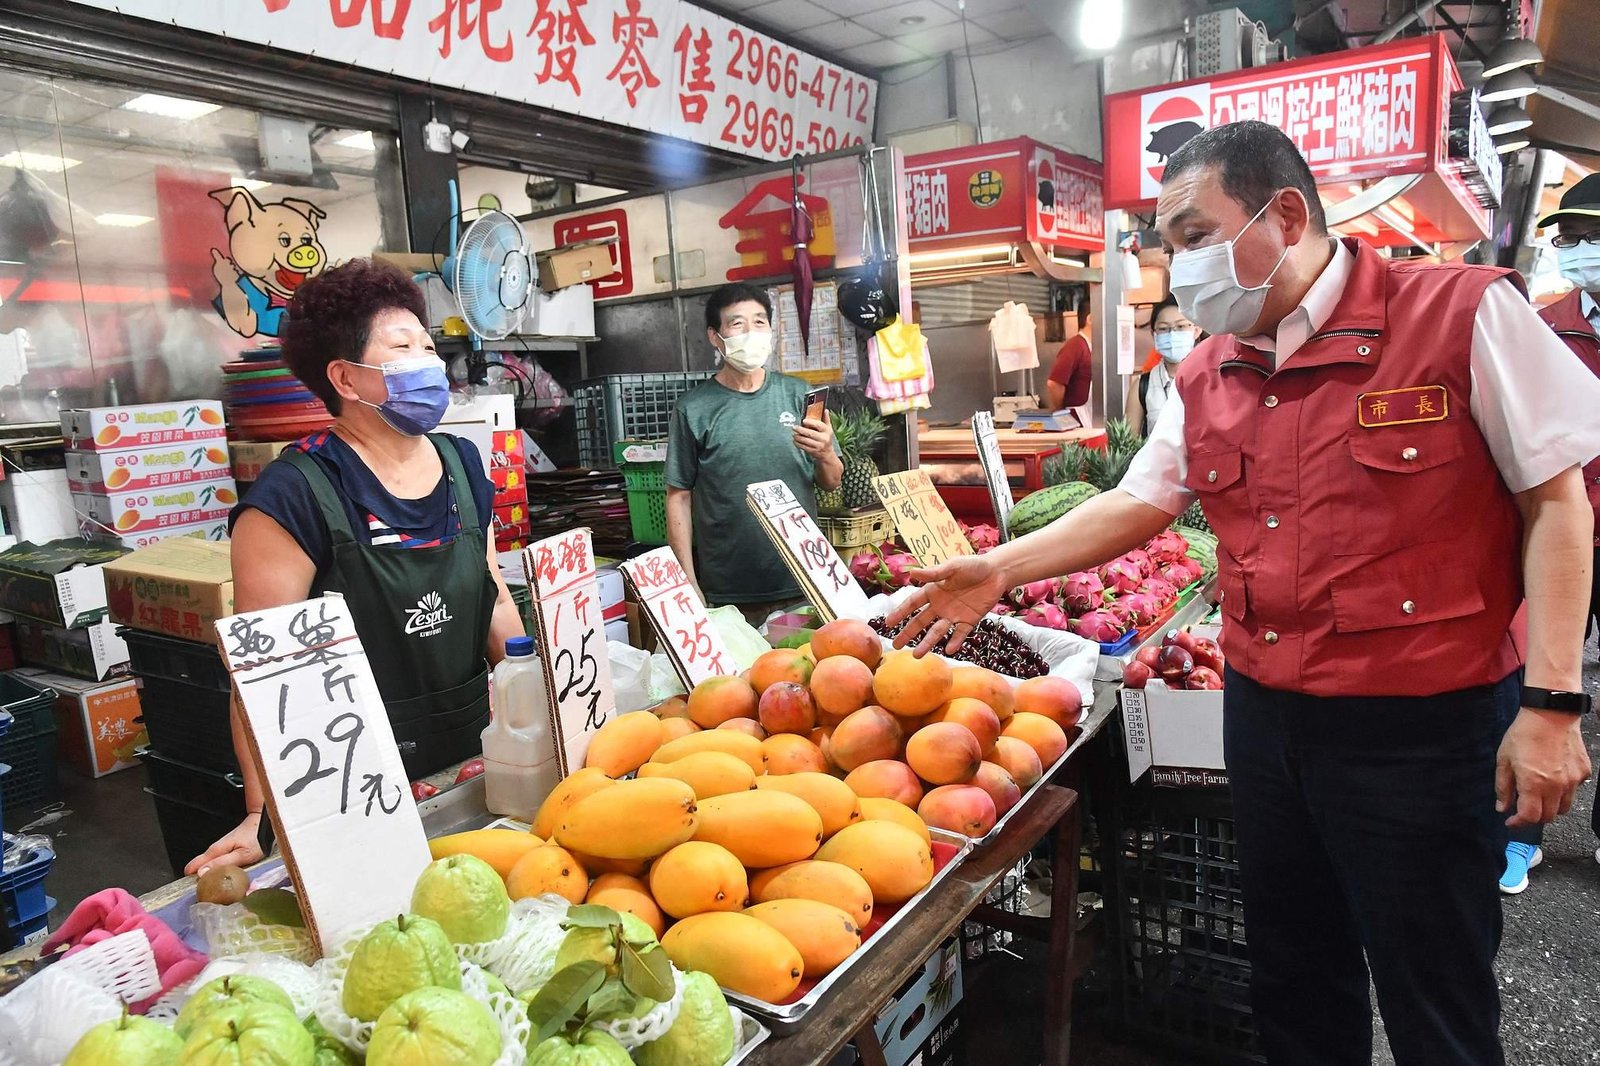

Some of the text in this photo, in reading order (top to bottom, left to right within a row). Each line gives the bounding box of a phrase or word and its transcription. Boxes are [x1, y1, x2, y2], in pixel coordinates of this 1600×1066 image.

[262, 0, 716, 124] 批發零售
[727, 29, 868, 124] 2966-4712
[720, 94, 863, 157] 2969-59
[134, 410, 178, 425] Mango
[143, 451, 185, 465] Mango
[153, 491, 195, 506] Mango
[405, 604, 452, 634] Zespri
[1153, 769, 1229, 786] Family Tree Farm
